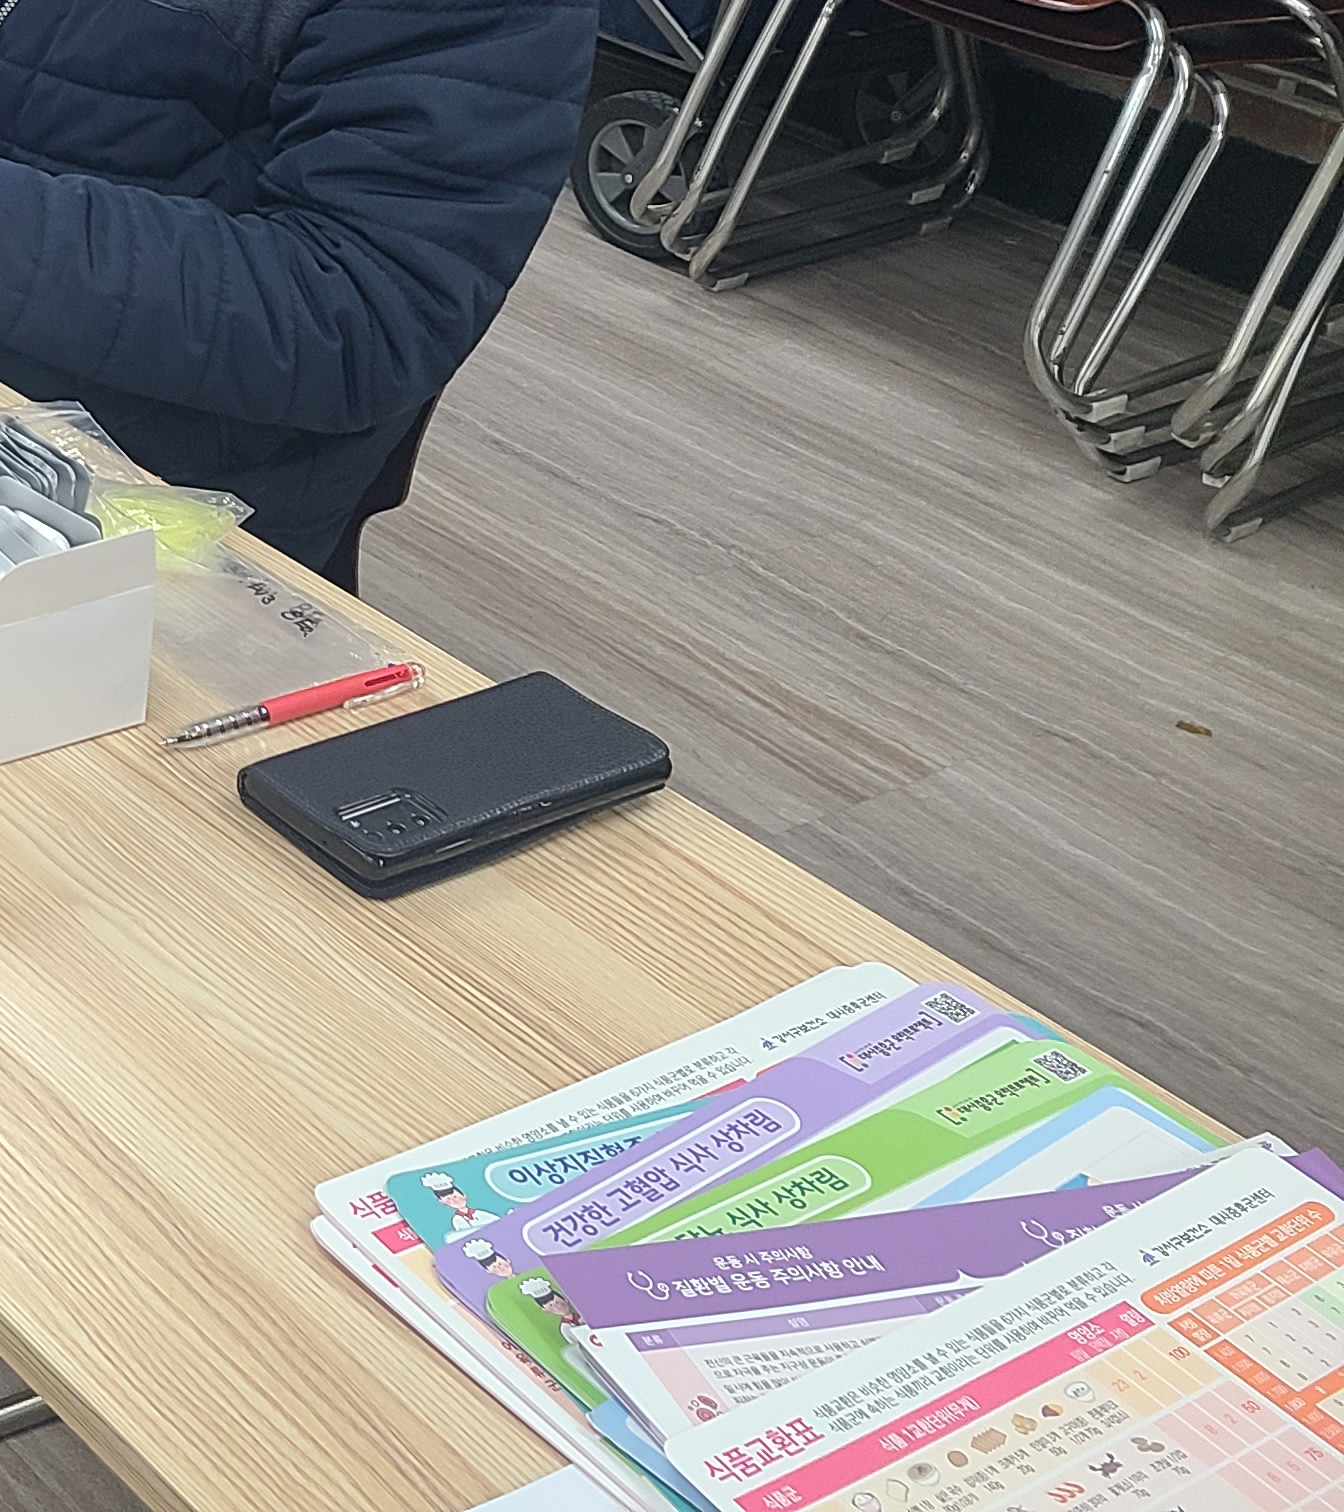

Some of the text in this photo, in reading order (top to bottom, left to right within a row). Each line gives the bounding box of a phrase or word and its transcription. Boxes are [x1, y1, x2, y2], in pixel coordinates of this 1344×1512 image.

[825, 991, 888, 1020] 대사증후군센터
[520, 1116, 558, 1145] 영양소를
[569, 1111, 580, 1125] 수
[577, 1102, 601, 1122] 있는
[595, 1088, 631, 1114] 식품들을
[629, 1078, 655, 1098] 6가지
[651, 1061, 694, 1090] 식품군별로
[692, 1050, 728, 1072] 분류하고
[725, 1044, 739, 1061] 각
[628, 1092, 664, 1117] 사용하여
[663, 1079, 690, 1101] 바꾸어
[687, 1073, 708, 1092] 먹을
[705, 1068, 718, 1083] 수
[714, 1055, 754, 1079] 있습니다.
[542, 1107, 783, 1248] 건강한 고혈압 식사 상차림
[725, 1166, 850, 1228] 식사 상차림
[1158, 1187, 1276, 1259] 강서구보건소 대사증후군센터
[673, 1253, 887, 1299] 질환별 운동 주의사항 안내
[713, 1244, 814, 1271] 운동 시 주의사항
[1153, 1207, 1324, 1307] 처방열량에 따른 1일 식품군별 교환단위 수
[812, 1259, 1118, 1421] 식품교환은 비슷한 영양소를 낼 수 있는 식품들을 6가지 식품군별로 분류하고 각
[1066, 1321, 1106, 1345] 영양소
[1118, 1309, 1146, 1328] 열량
[712, 1369, 733, 1380] 으로
[761, 1362, 781, 1374] 주는
[828, 1272, 1137, 1434] 식품군에 속하는 식품끼리 교환이라는 단위를 사용하여 바꾸어 먹을 수 있습니다.
[1133, 1369, 1148, 1381] 2
[1168, 1346, 1191, 1362] 100
[1112, 1378, 1131, 1394] 23
[879, 1395, 981, 1453] 식품 1교환단위(무게)
[703, 1416, 826, 1483] 식품교환표
[1303, 1446, 1325, 1461] 75
[762, 1484, 803, 1511] 식품군
